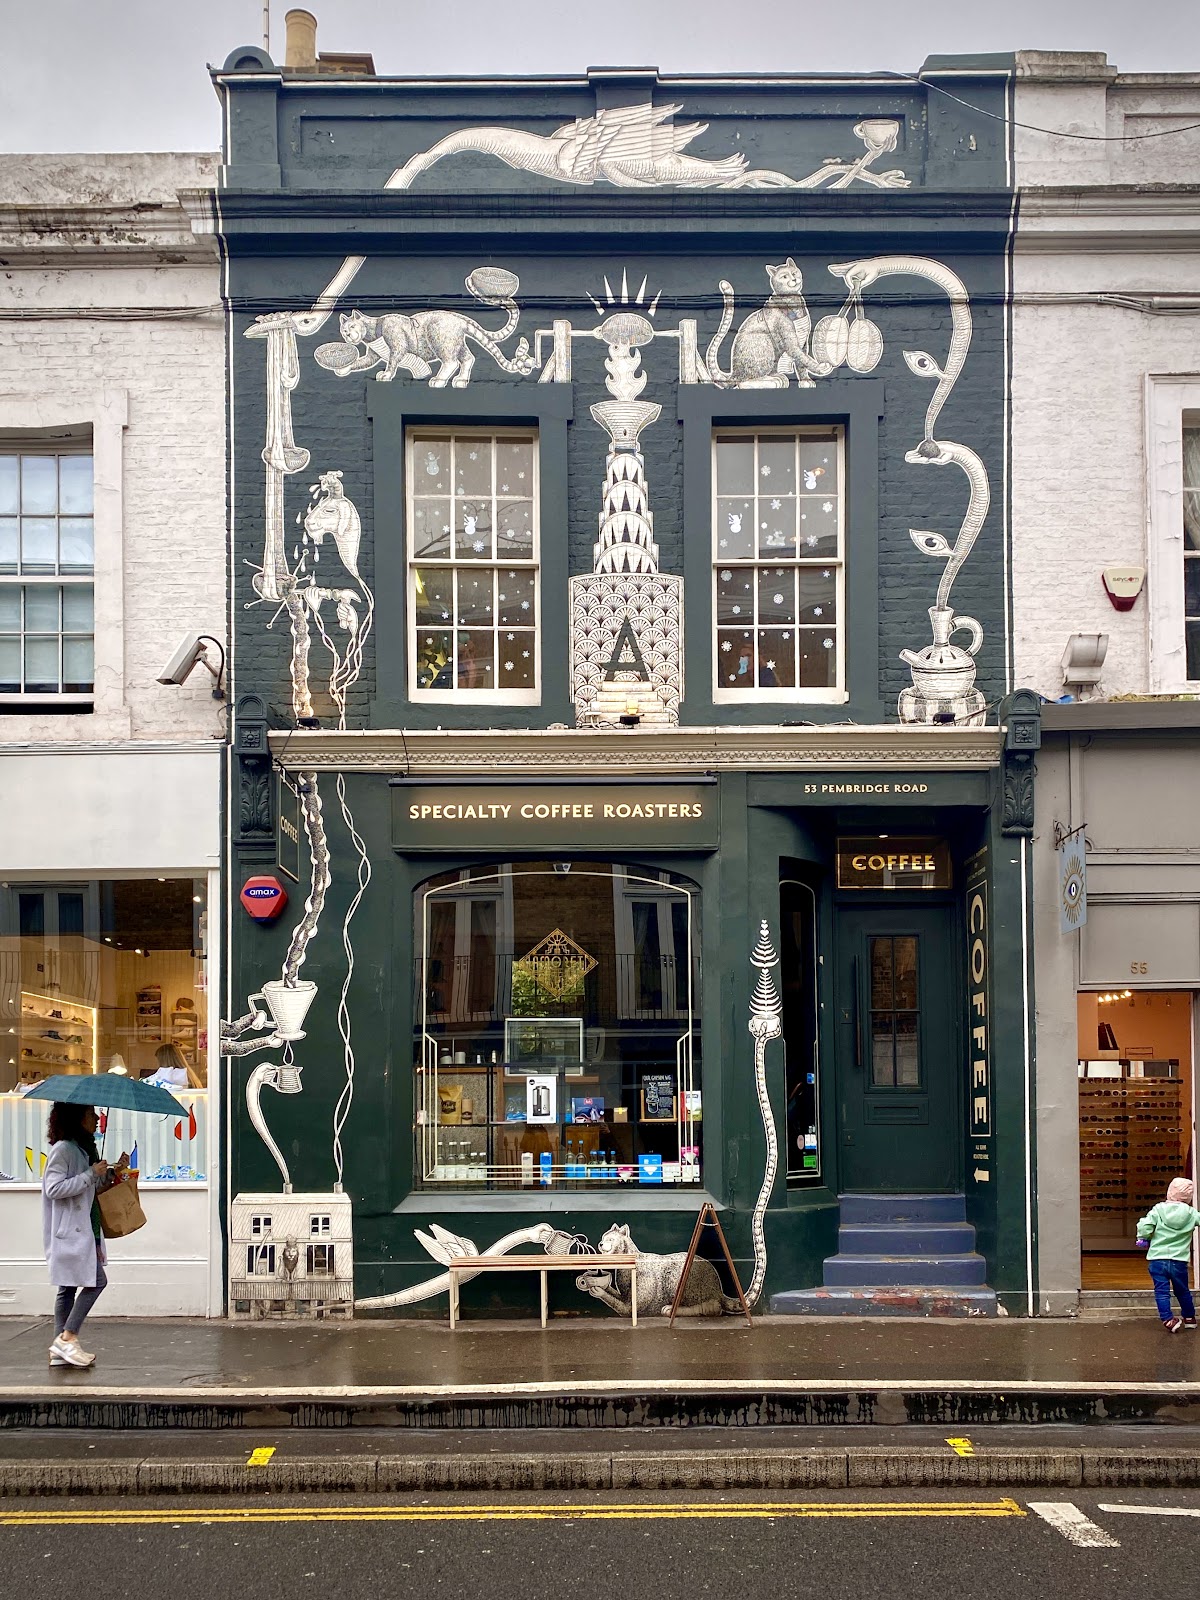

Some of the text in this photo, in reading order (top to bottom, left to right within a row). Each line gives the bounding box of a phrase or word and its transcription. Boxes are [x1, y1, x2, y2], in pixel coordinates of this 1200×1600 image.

[804, 784, 928, 793] 53 PEMBRIDGE ROAD
[409, 803, 702, 819] SPECIALTY COFFEE ROASTERS
[280, 815, 298, 844] COFFEE
[852, 855, 936, 871] COFFEE
[1130, 961, 1148, 975] 55
[970, 894, 987, 1125] COFFEE
